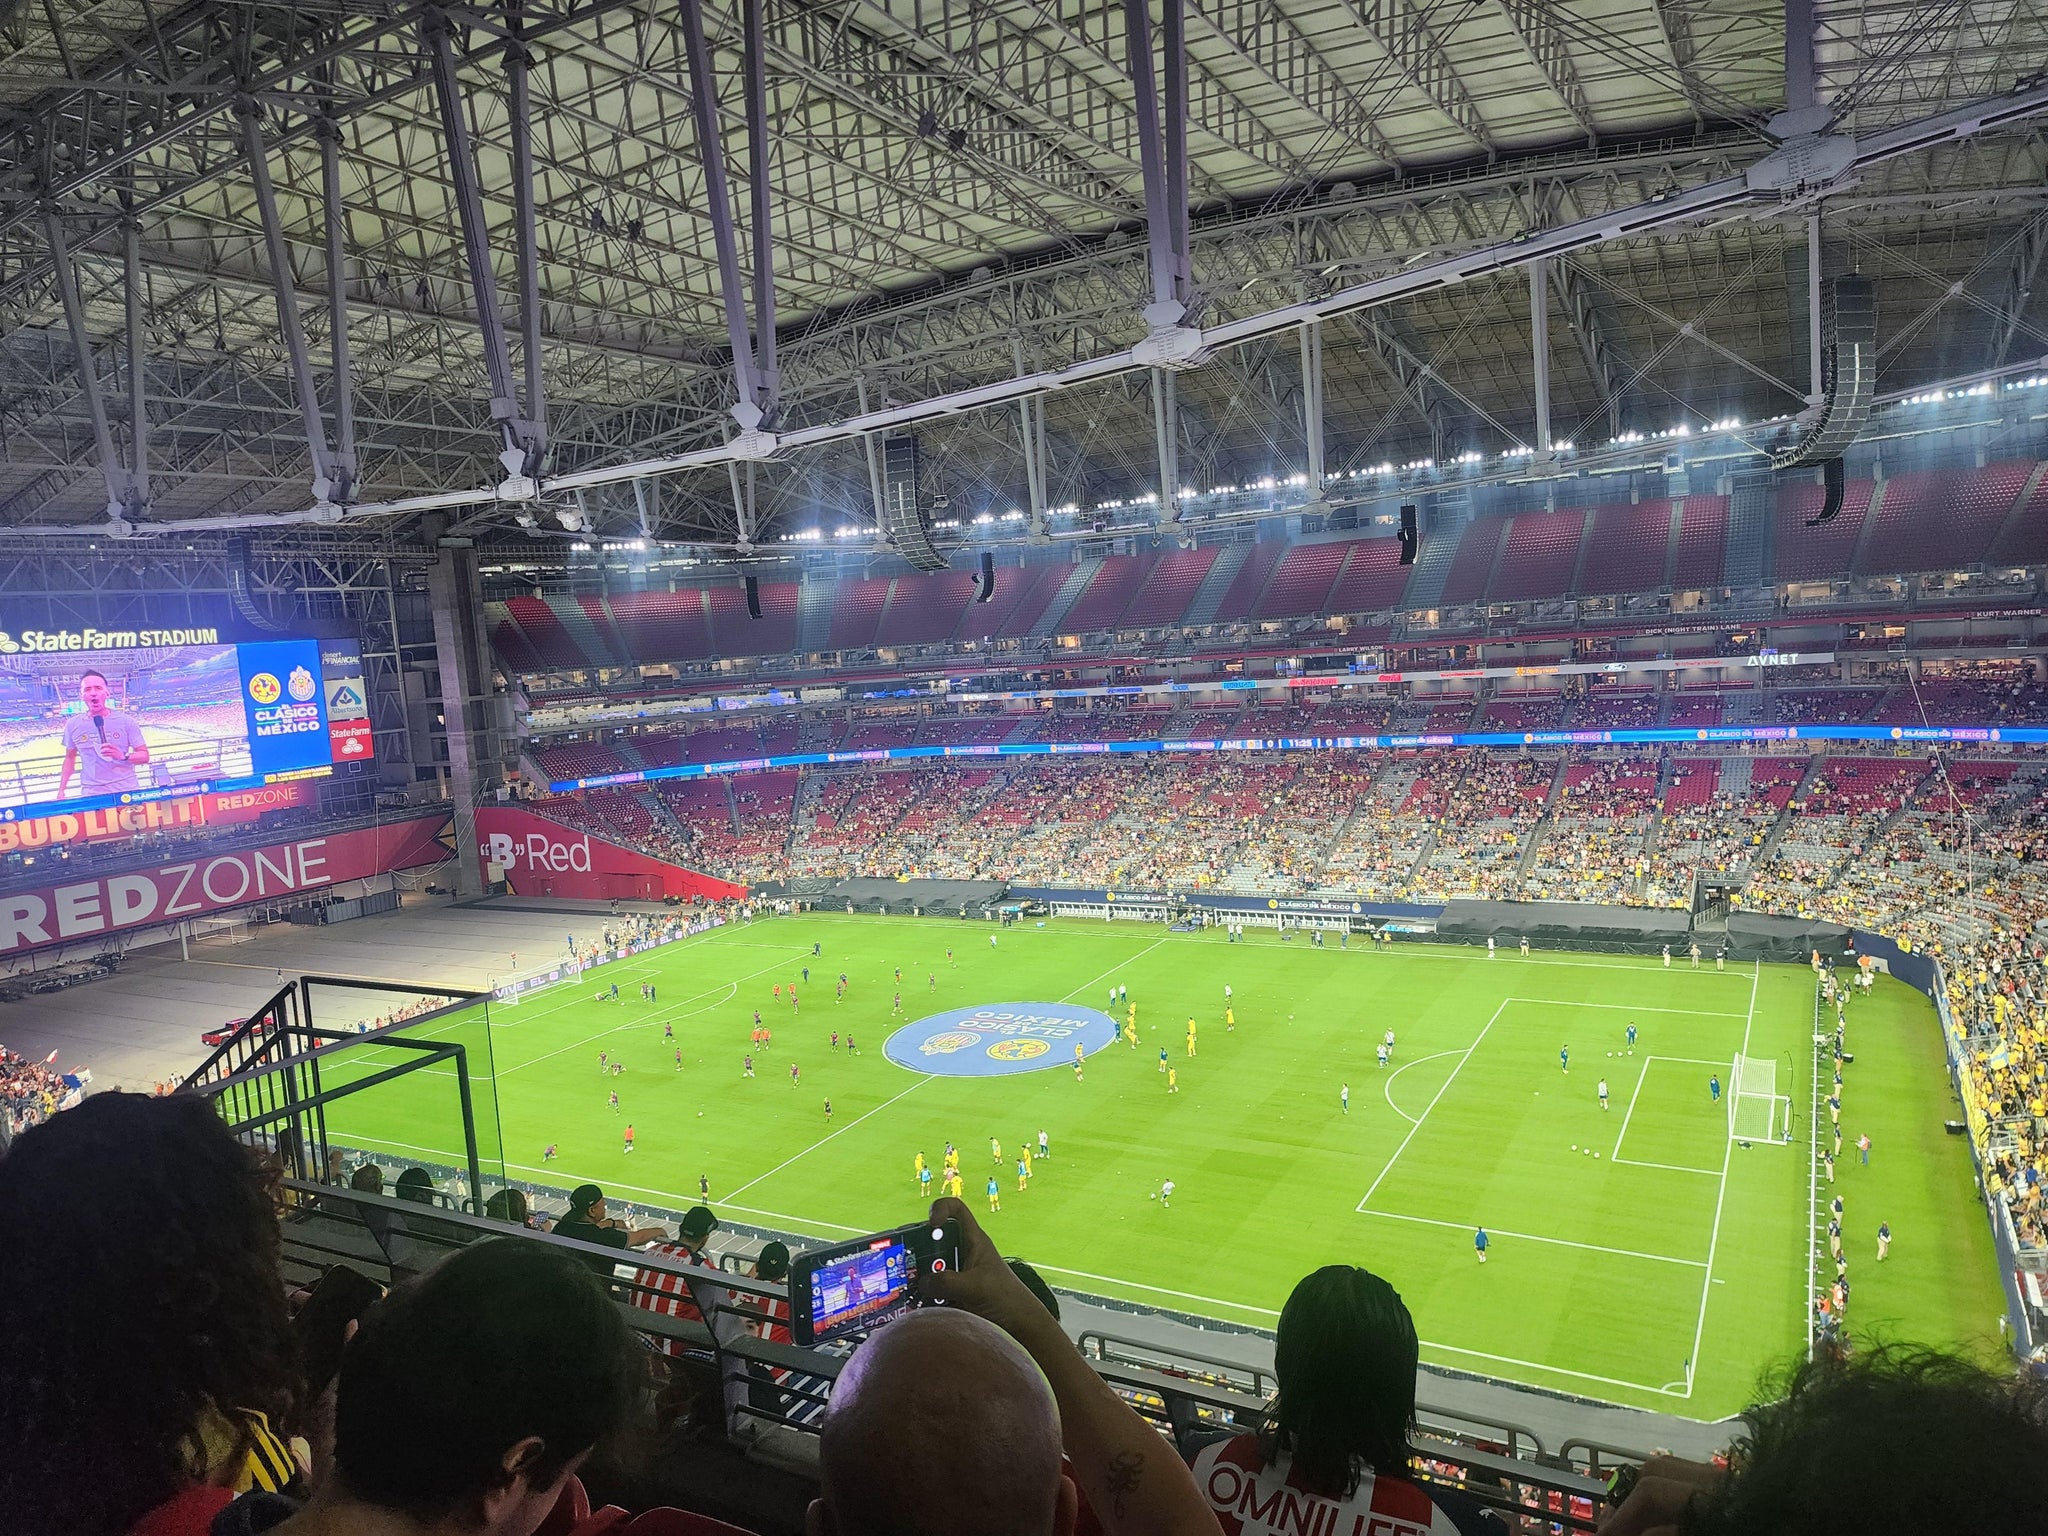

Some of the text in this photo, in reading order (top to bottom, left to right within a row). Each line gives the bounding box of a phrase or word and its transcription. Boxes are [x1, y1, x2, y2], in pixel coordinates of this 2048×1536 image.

[1664, 626, 1690, 634] (NIGHT
[21, 629, 218, 652] StateFarm STADIUM
[1748, 653, 1798, 666] AVNET
[255, 706, 318, 721] CLÁSICO
[257, 721, 320, 736] MÉXICO
[331, 727, 370, 738] StateFarm
[1952, 730, 1988, 738] MÉXICO
[1360, 737, 1377, 746] CHI
[217, 787, 299, 811] REDZONE
[0, 798, 196, 850] BUD LIGHT
[0, 840, 331, 950] REDZONE
[688, 917, 726, 934] VIVE EL
[632, 935, 672, 953] VIVE EL
[566, 956, 610, 975] VIVE EL
[495, 977, 545, 998] VIVE EL
